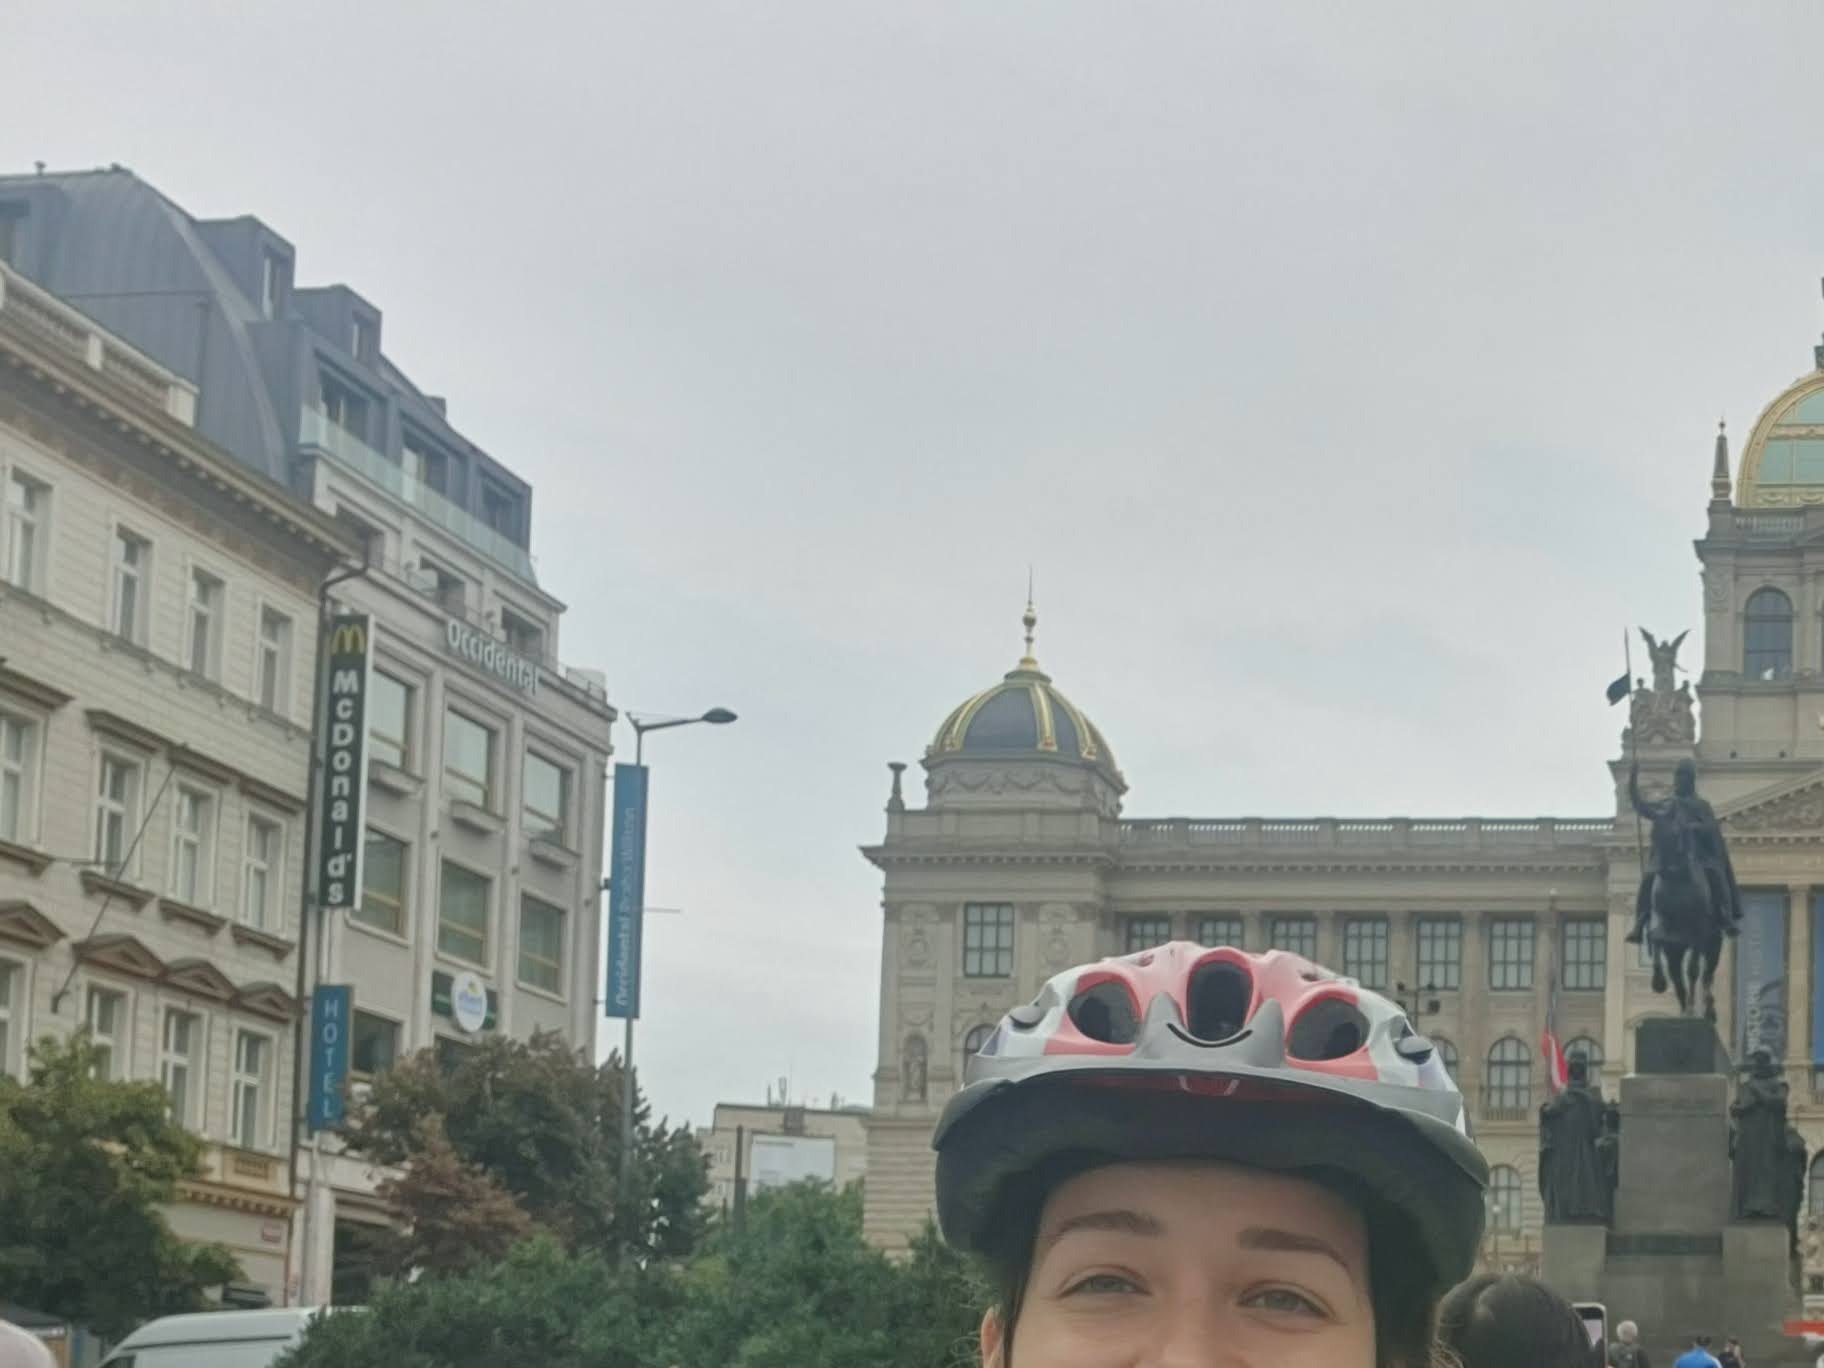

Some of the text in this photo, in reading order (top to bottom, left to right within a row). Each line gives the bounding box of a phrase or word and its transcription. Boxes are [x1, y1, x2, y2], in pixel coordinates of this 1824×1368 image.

[448, 619, 538, 695] Occidental
[327, 669, 359, 904] McDonald's
[322, 999, 339, 1119] HOTEL
